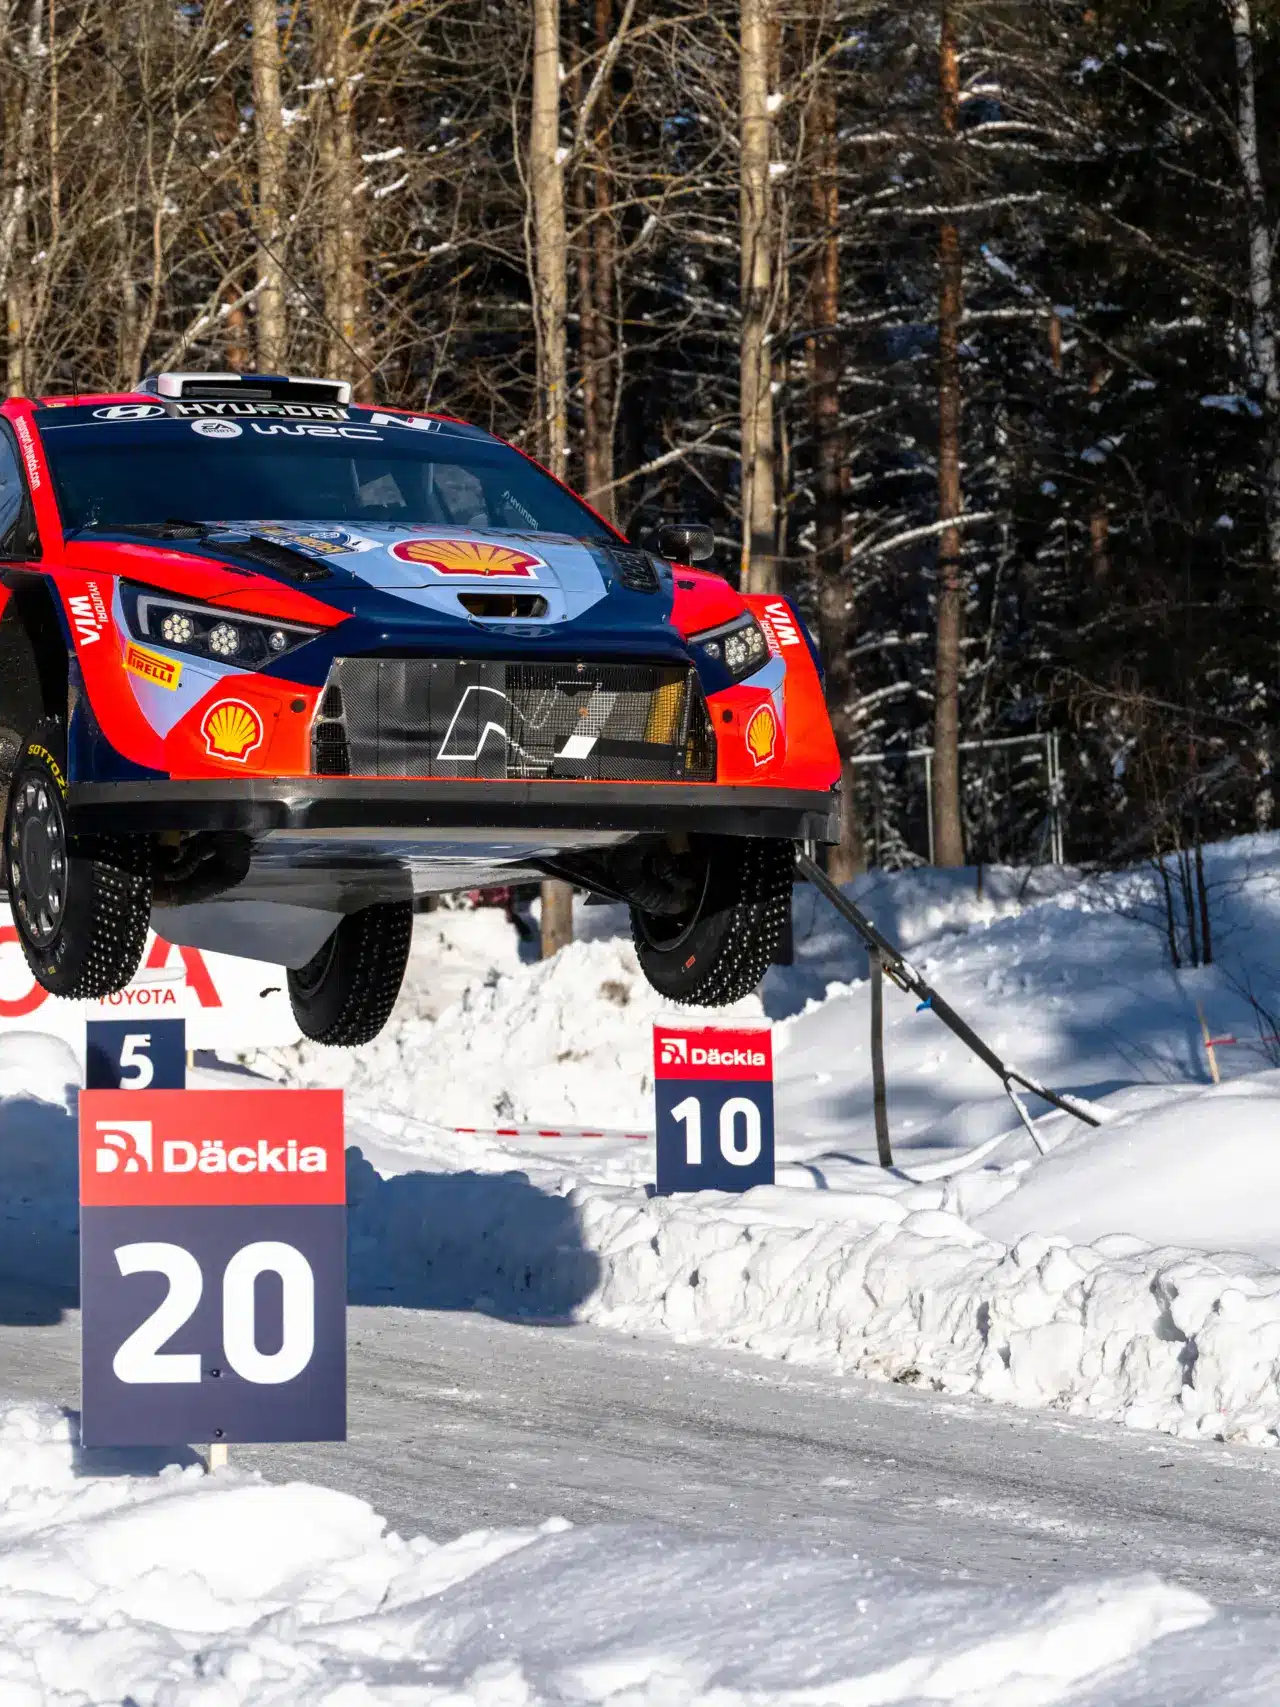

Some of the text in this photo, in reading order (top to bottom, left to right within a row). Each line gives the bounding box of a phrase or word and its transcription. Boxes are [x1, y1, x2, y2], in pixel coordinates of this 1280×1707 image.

[250, 422, 384, 440] WRC
[68, 595, 102, 646] WIA
[85, 581, 109, 623] HYUNDAI
[764, 602, 800, 646] WIA
[127, 647, 176, 684] PIRELLI
[119, 1034, 154, 1090] 5
[690, 1048, 766, 1066] Däckia
[670, 1096, 762, 1166] 10
[163, 1140, 328, 1173] Däckia
[112, 1241, 315, 1385] 20
